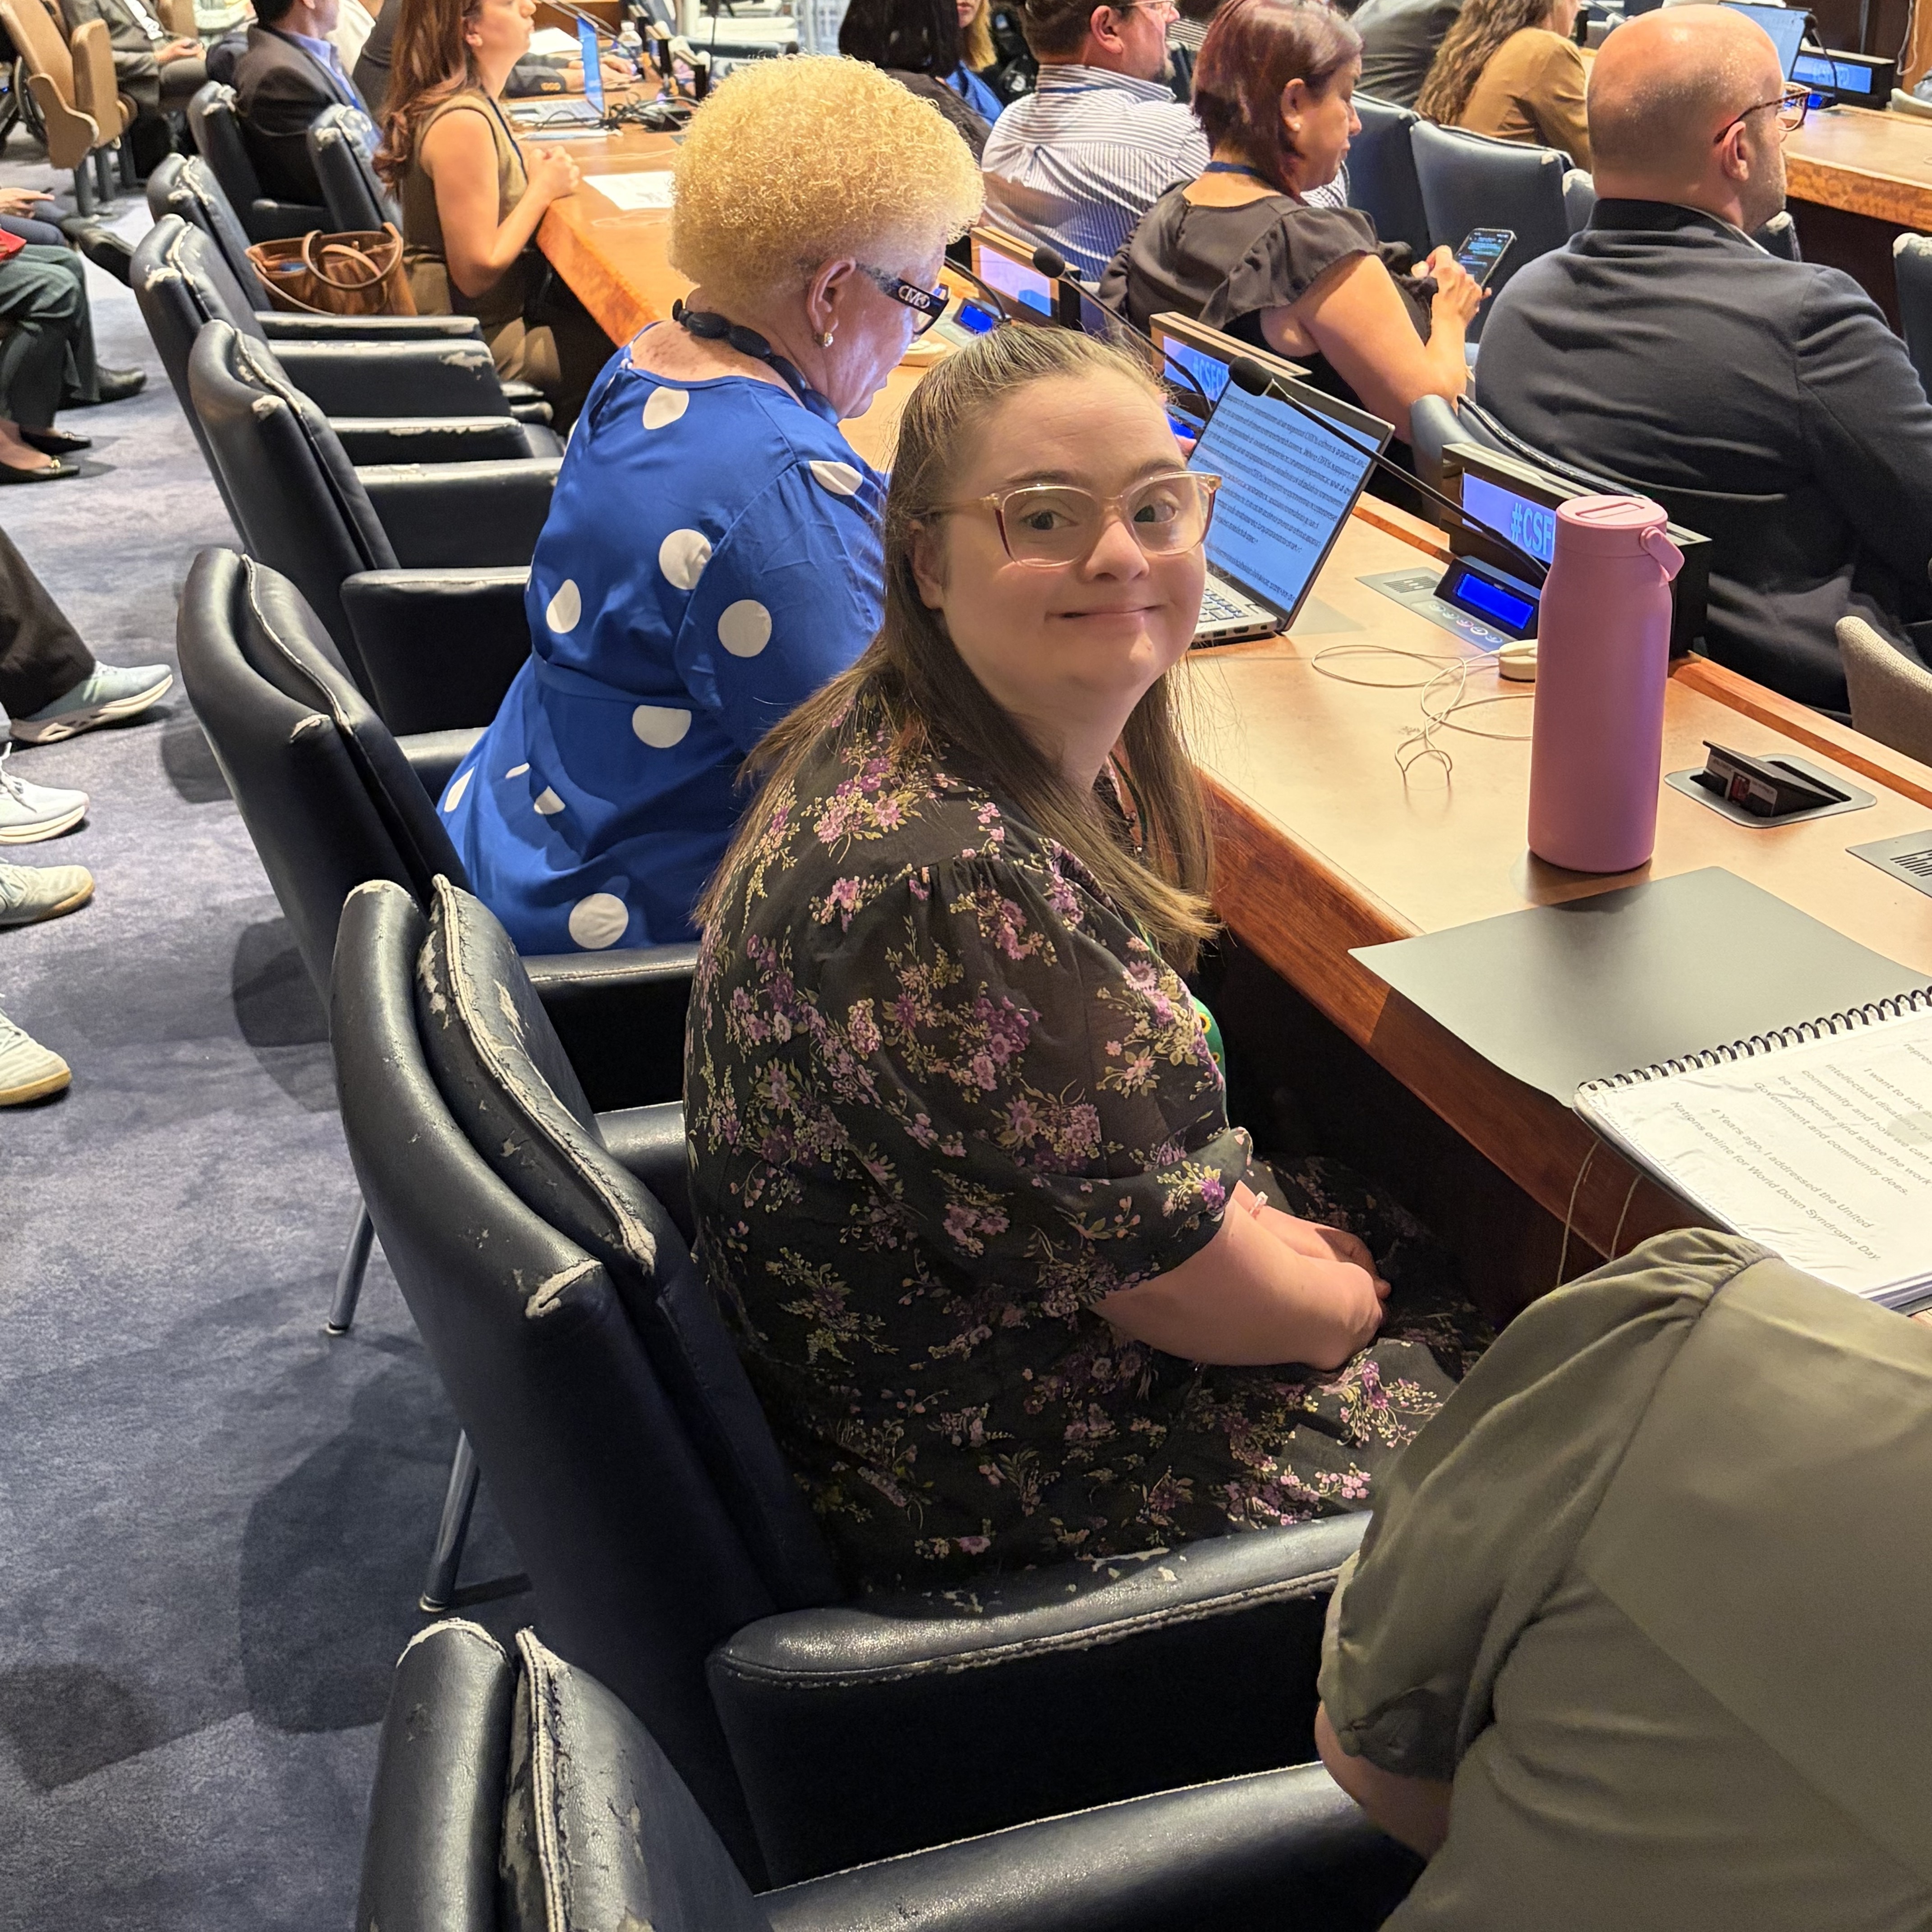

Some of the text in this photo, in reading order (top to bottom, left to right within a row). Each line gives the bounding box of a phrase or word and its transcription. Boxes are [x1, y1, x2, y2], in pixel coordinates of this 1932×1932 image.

[1511, 502, 1555, 555] #CSF
[1754, 1082, 1908, 1195] Government and community does.
[1777, 1076, 1932, 1185] be advocates and shape the work
[1801, 1069, 1930, 1160] community and how we can
[1826, 1064, 1878, 1101] intellectual
[1876, 1100, 1921, 1131] disability
[1869, 1072, 1895, 1089] want
[1904, 1097, 1924, 1110] talk
[1670, 1102, 1881, 1261] Nations online for World Down Syndrome Day.
[1718, 1114, 1744, 1136] Years
[1743, 1136, 1763, 1152] ago,
[1769, 1156, 1822, 1192] addressed
[1819, 1192, 1837, 1205] the
[1837, 1204, 1874, 1228] United
